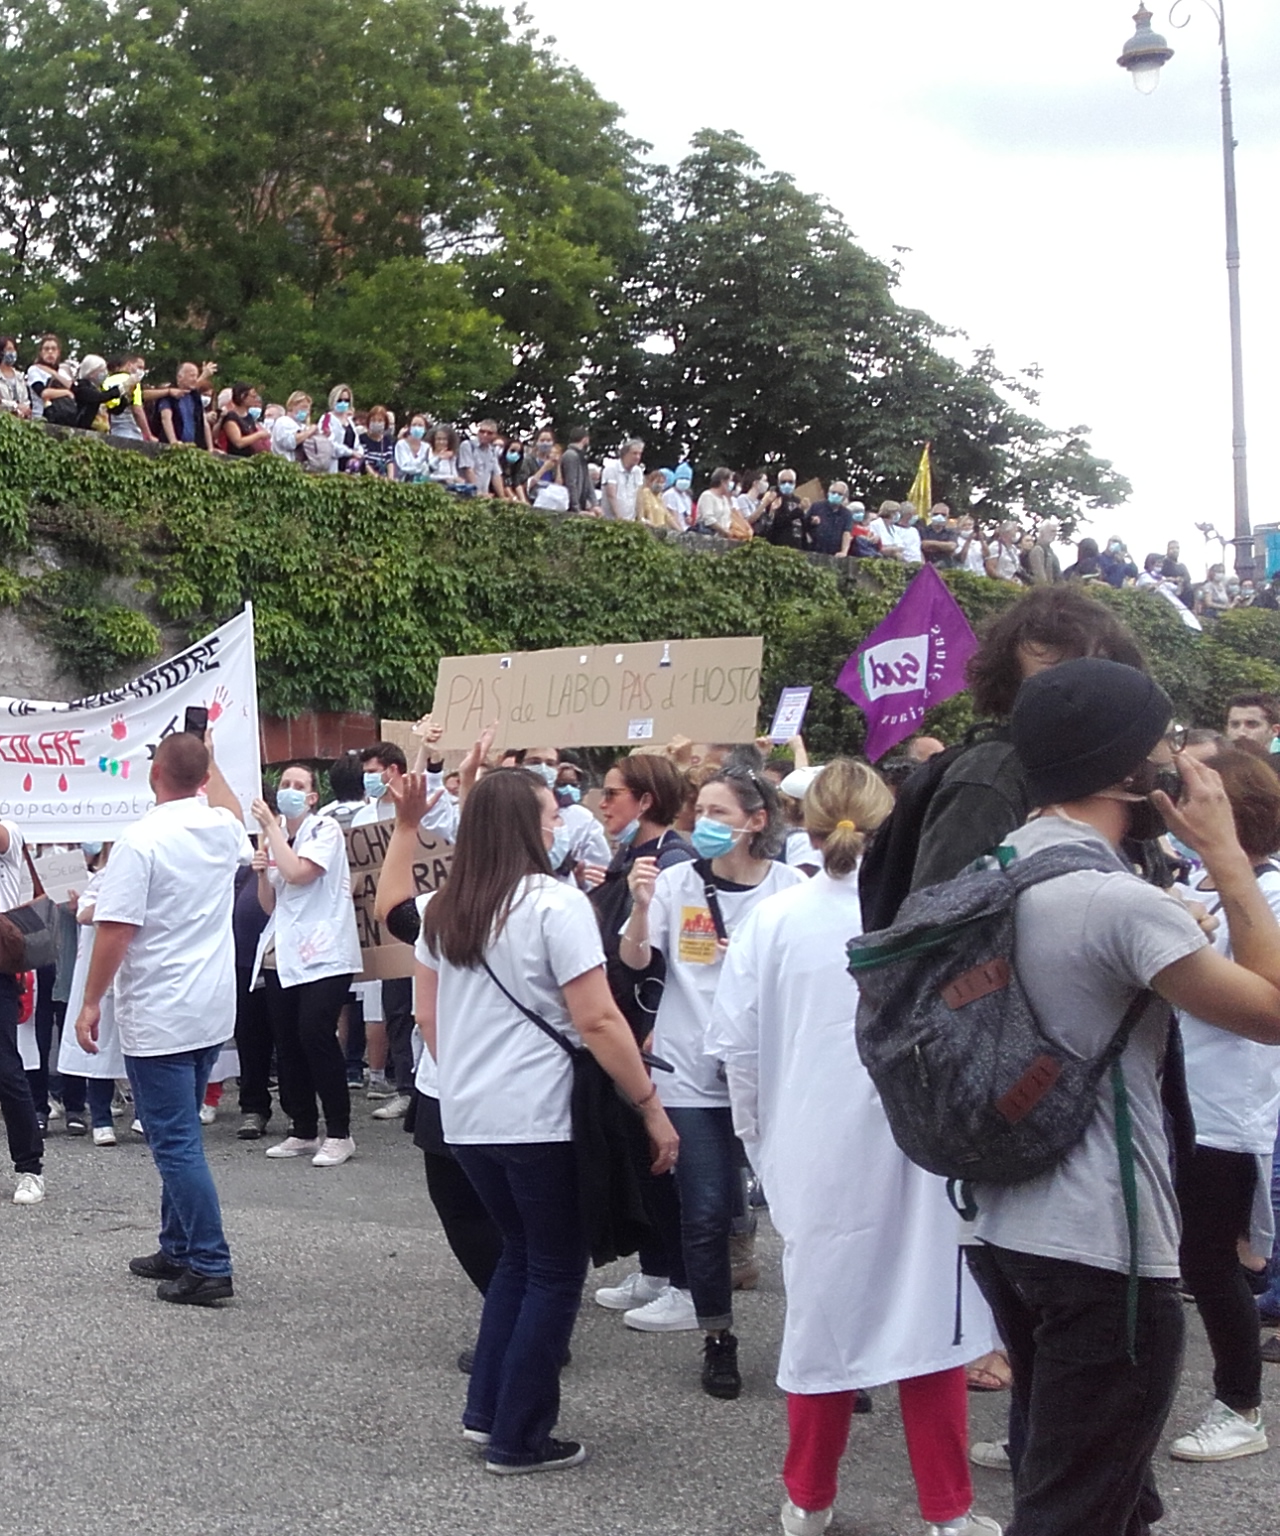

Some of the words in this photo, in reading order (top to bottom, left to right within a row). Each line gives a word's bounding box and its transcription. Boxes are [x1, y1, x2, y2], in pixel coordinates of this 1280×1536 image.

[444, 674, 502, 731] PAS
[510, 674, 536, 723] de
[546, 673, 610, 717] LABO
[619, 670, 656, 712] PAS
